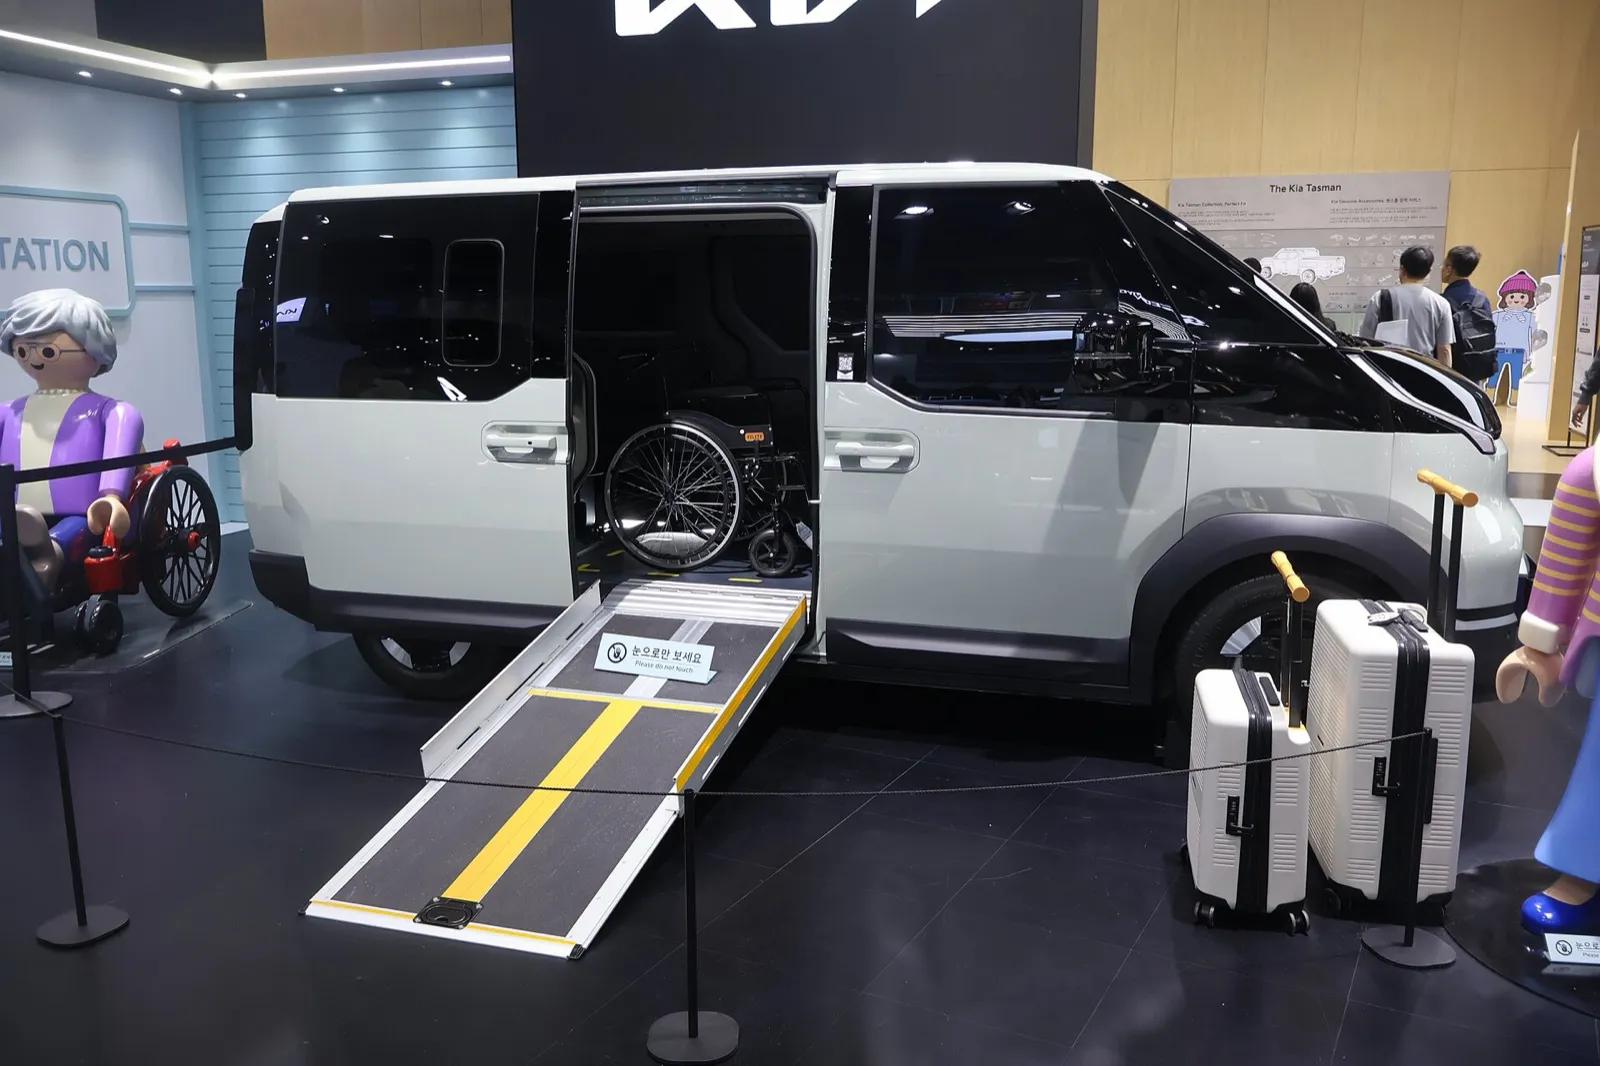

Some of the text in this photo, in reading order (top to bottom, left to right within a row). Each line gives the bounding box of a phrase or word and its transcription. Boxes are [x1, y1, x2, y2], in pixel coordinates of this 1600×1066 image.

[1270, 184, 1342, 192] The Kia Tasman
[632, 644, 702, 664] 눈으로만 보세요
[634, 660, 654, 668] Please
[676, 666, 694, 674] touch
